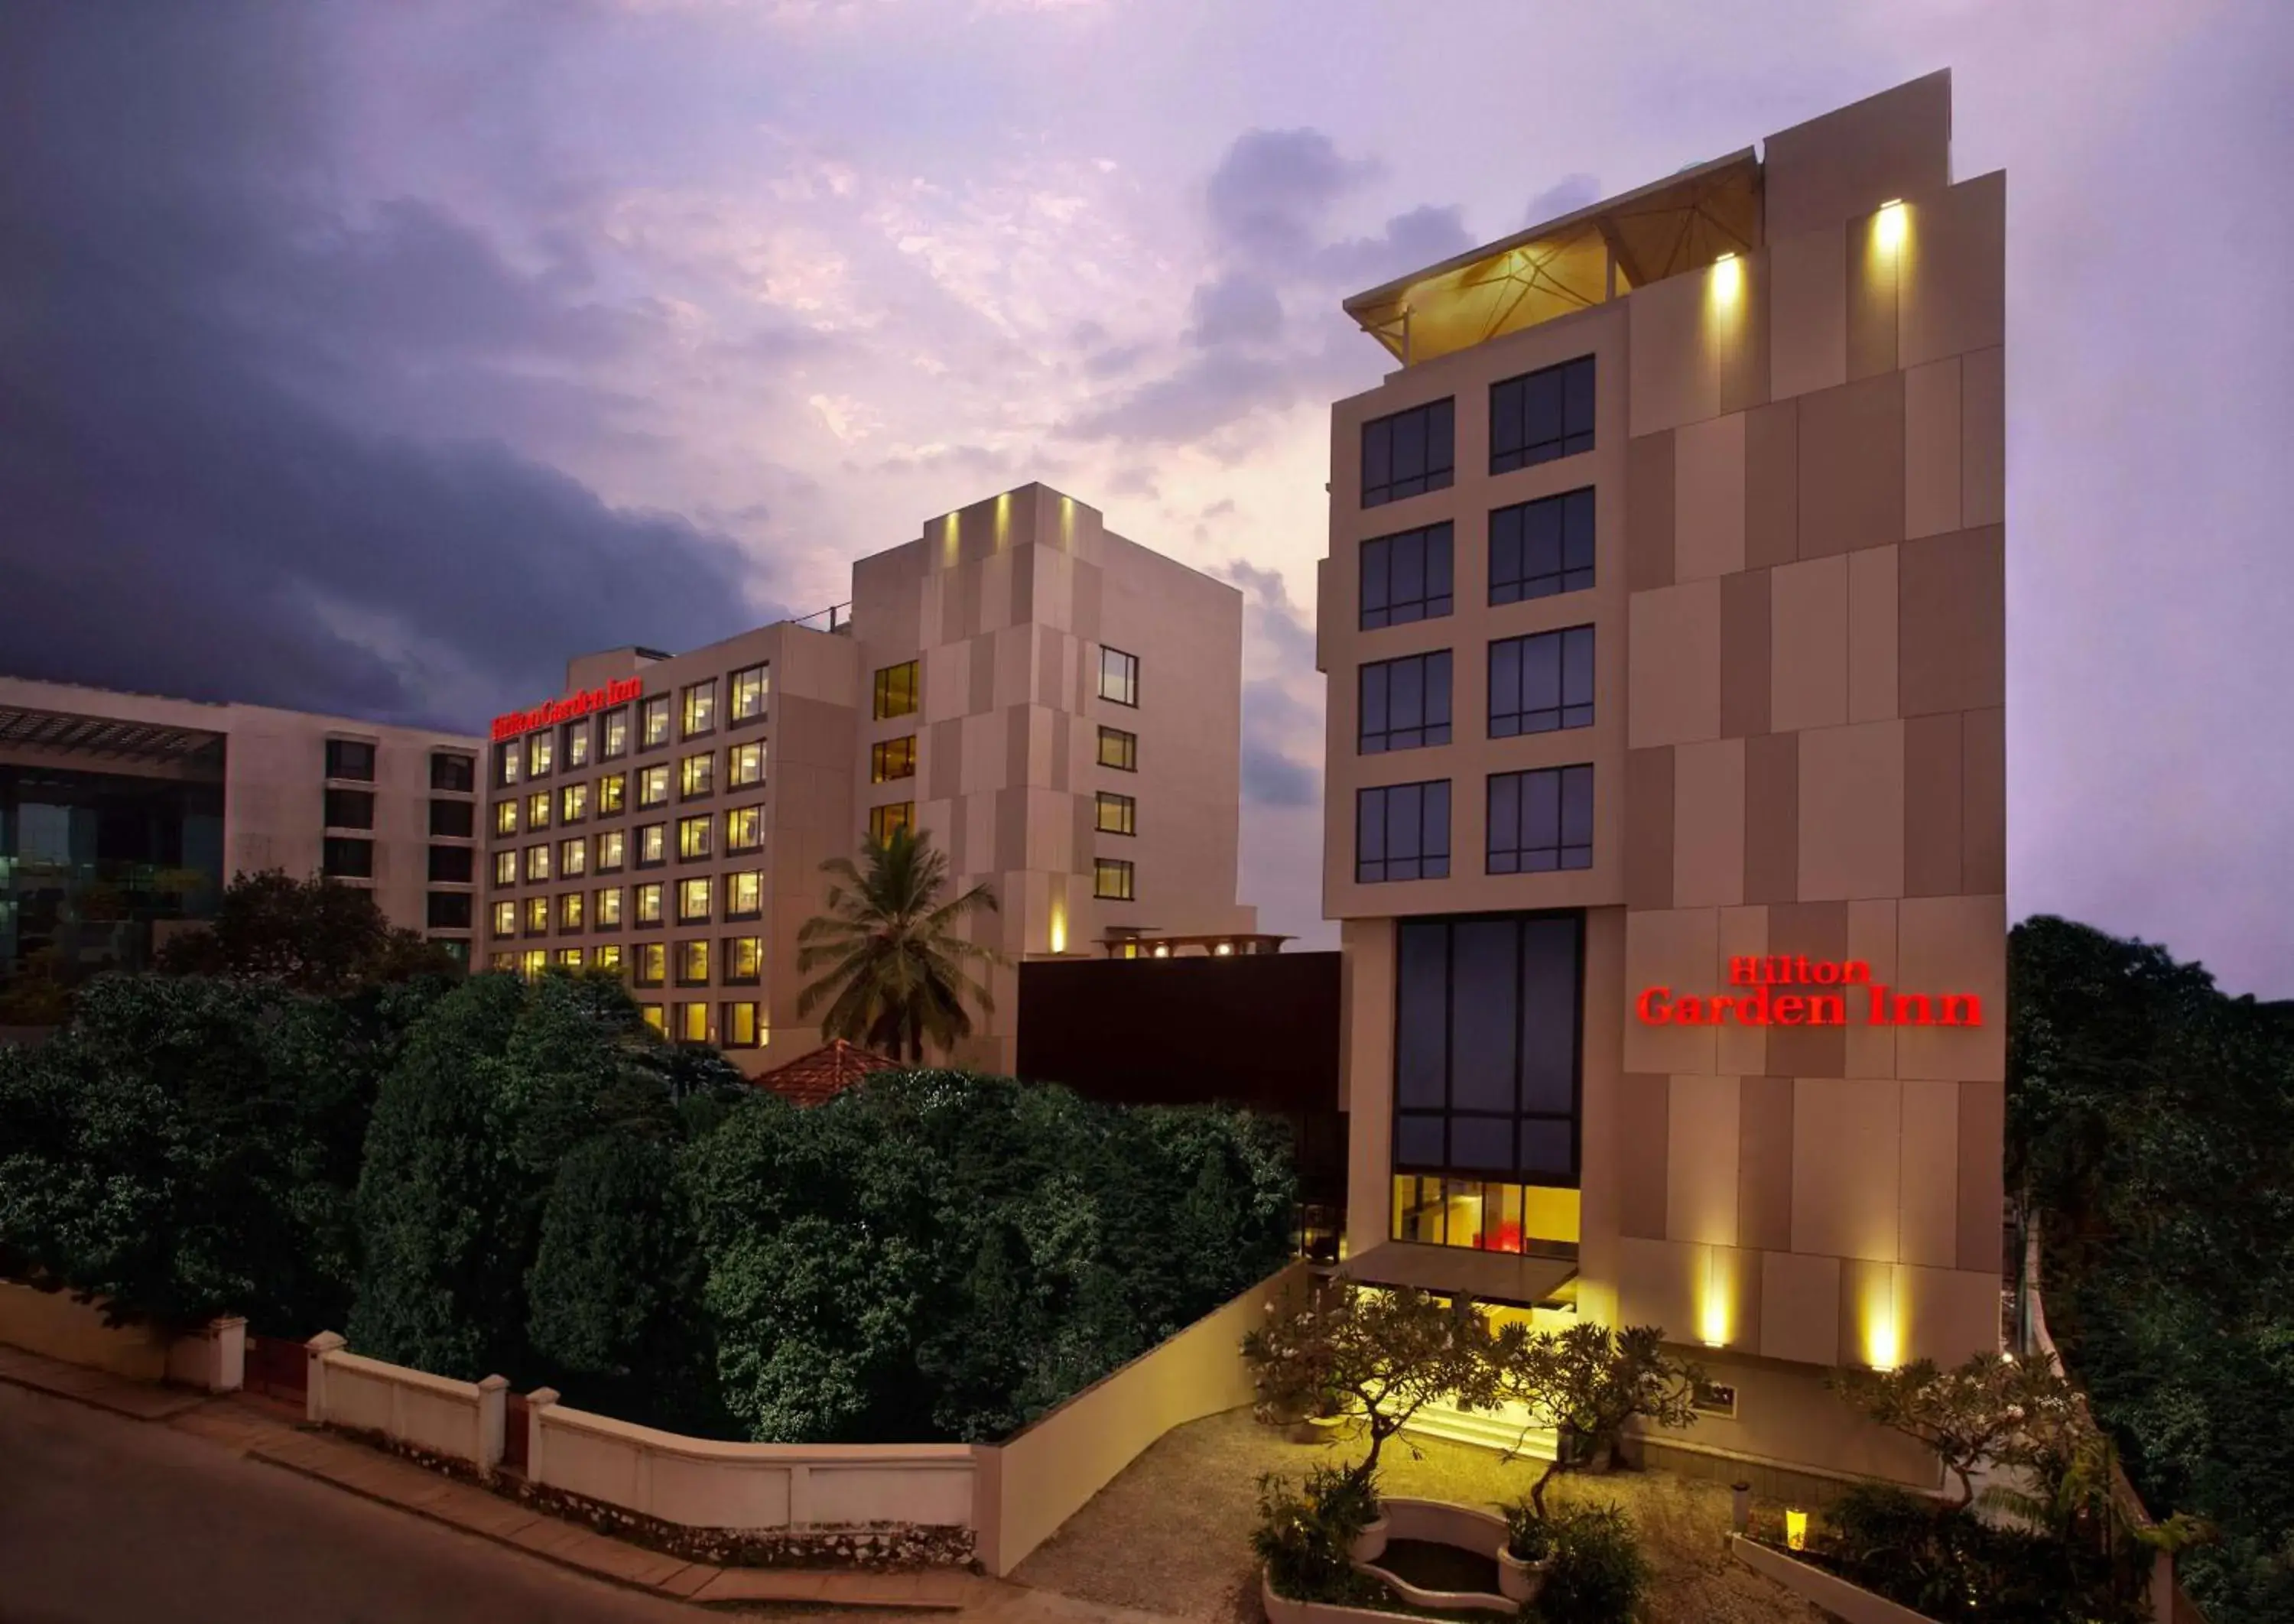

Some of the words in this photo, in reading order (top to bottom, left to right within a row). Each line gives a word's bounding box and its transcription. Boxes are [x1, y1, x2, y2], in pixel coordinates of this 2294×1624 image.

[1729, 955, 1870, 986] Hilton
[1636, 986, 1847, 1026] Garden
[1867, 984, 1983, 1027] Inn
